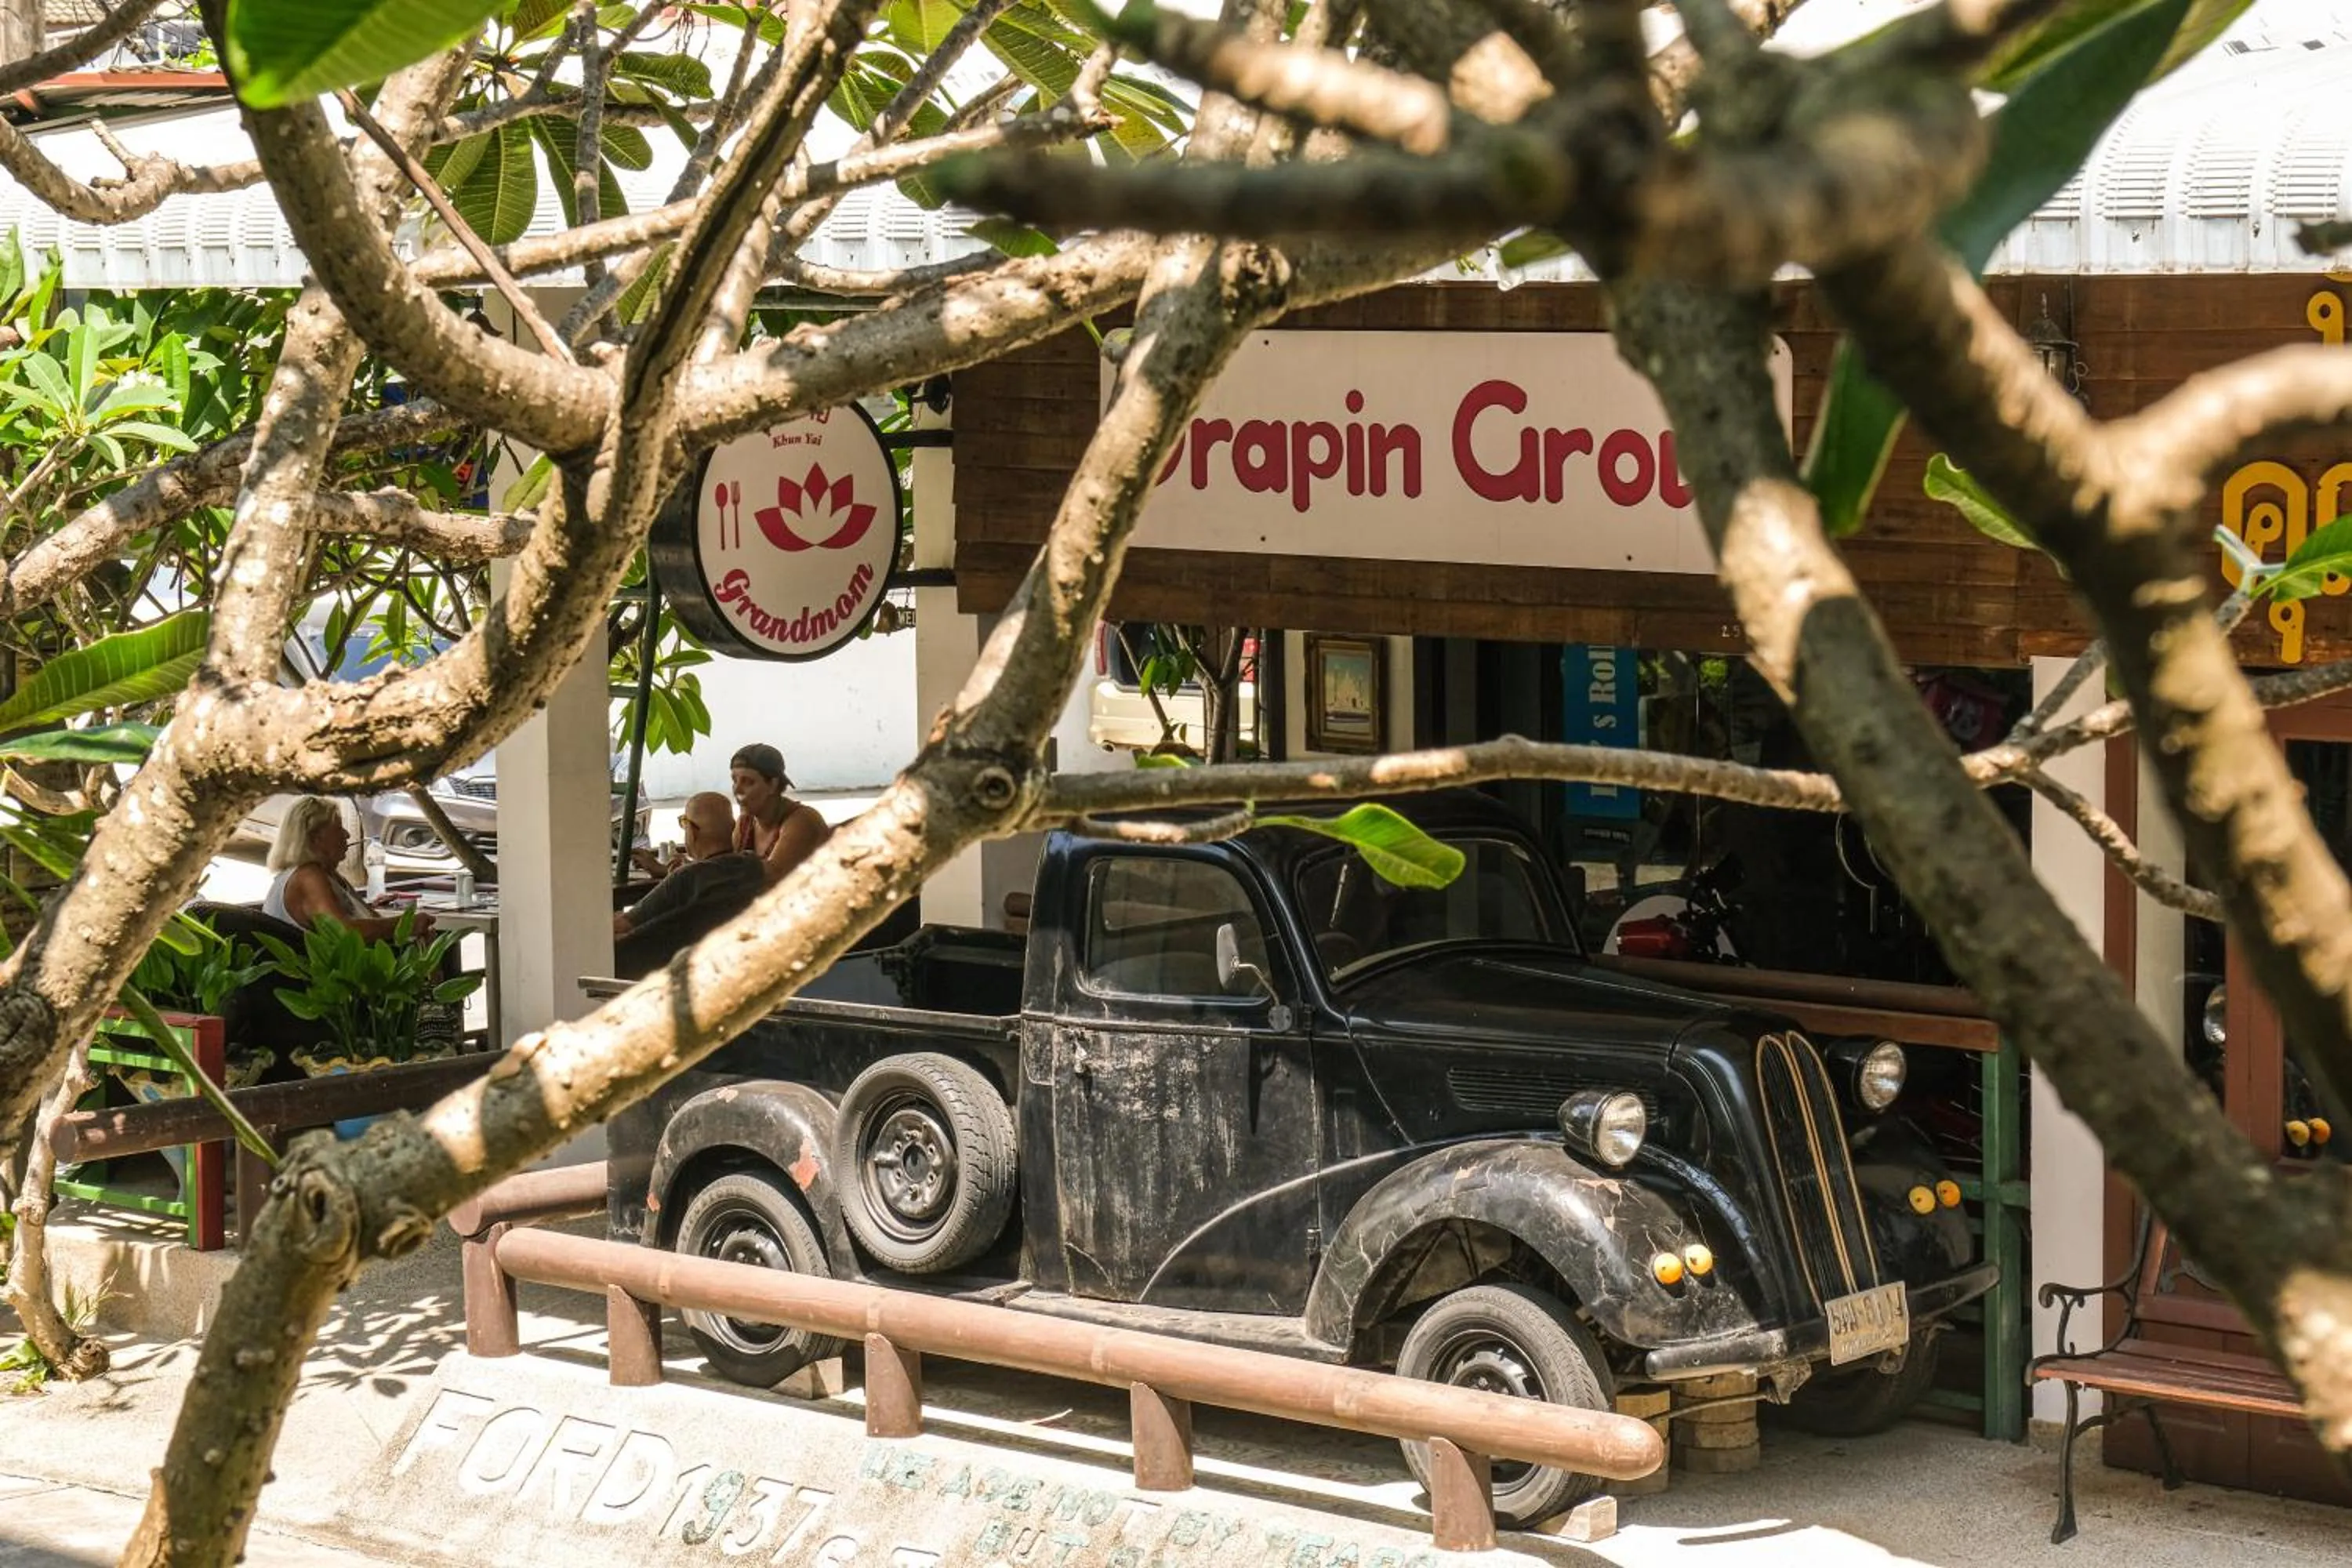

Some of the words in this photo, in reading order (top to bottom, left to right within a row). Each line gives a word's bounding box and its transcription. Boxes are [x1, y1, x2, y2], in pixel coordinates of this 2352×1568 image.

[713, 561, 875, 644] Grandmom
[390, 1387, 676, 1524] FORD
[659, 1463, 835, 1564] 1937
